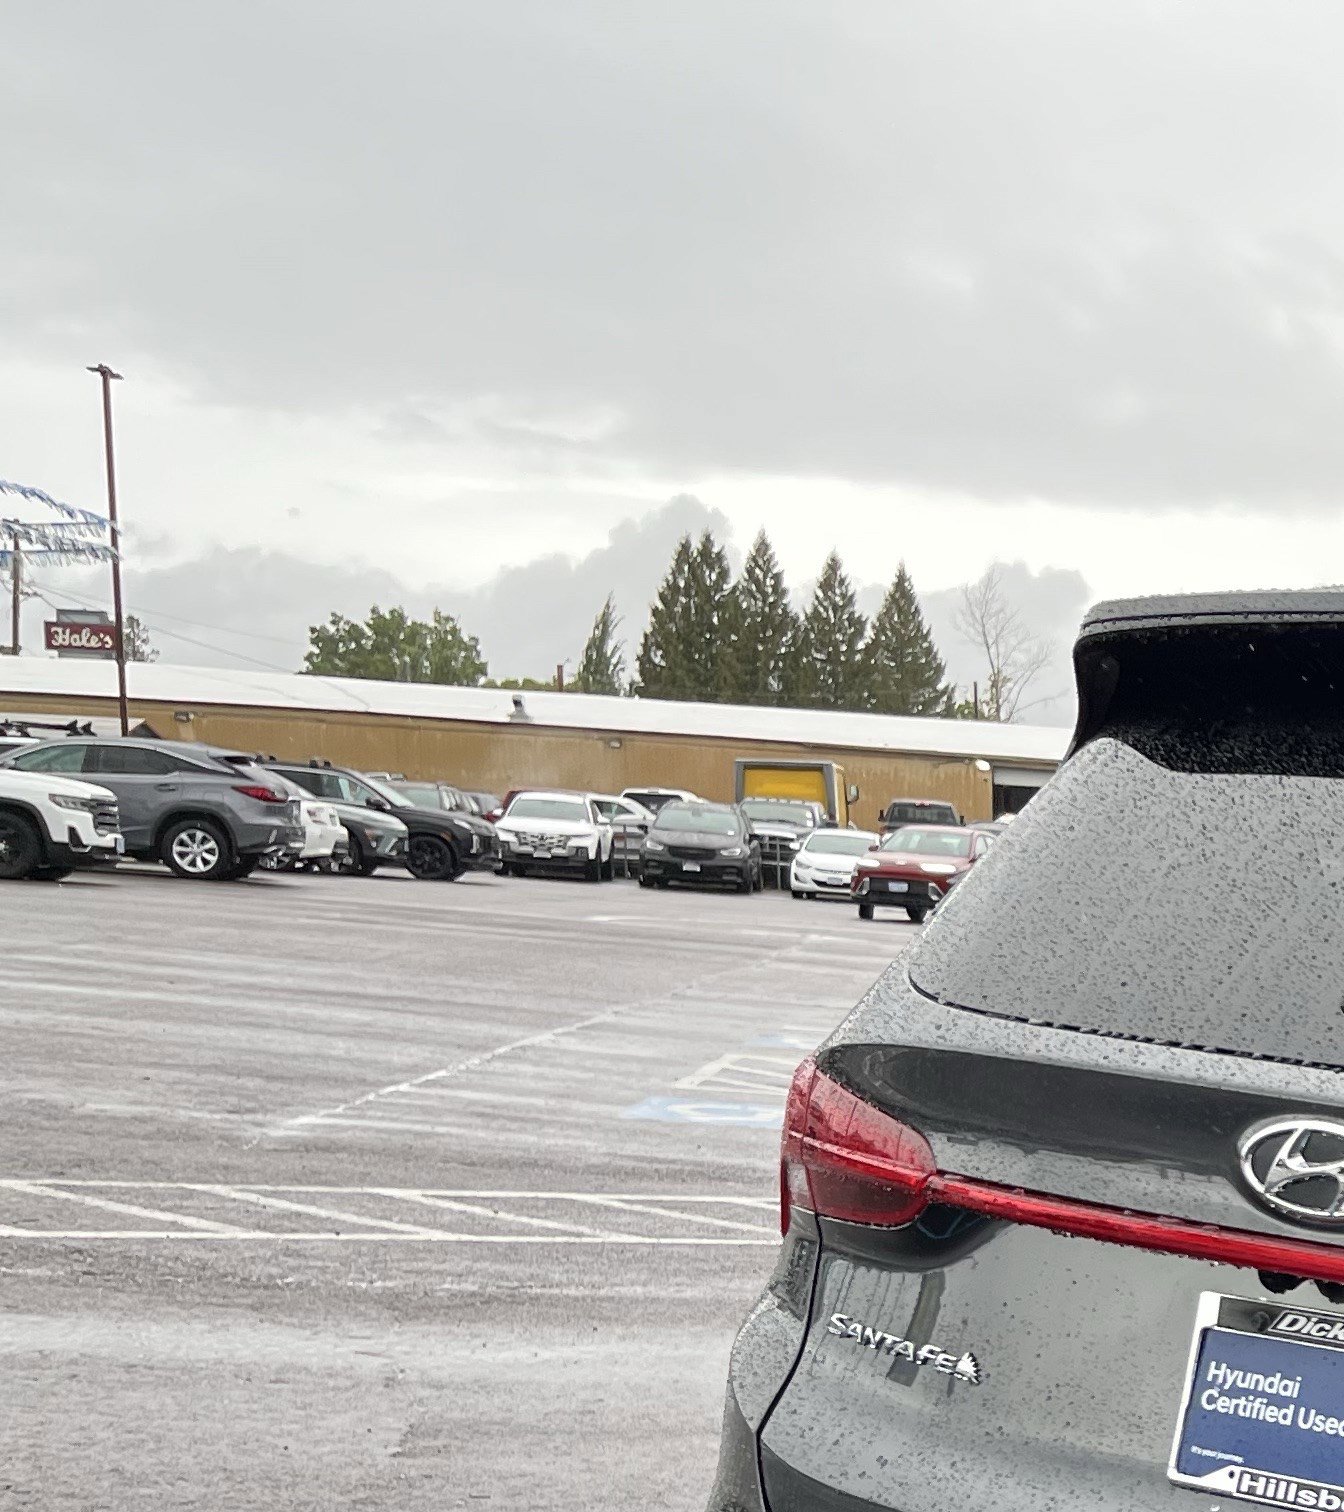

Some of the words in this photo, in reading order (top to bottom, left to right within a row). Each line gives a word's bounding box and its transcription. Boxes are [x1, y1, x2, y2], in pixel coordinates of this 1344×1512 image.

[50, 626, 113, 649] Hale's
[827, 1312, 916, 1363] SANTA
[915, 1343, 959, 1376] FE
[1206, 1361, 1302, 1399] Hyundai
[1200, 1388, 1295, 1426] Certified
